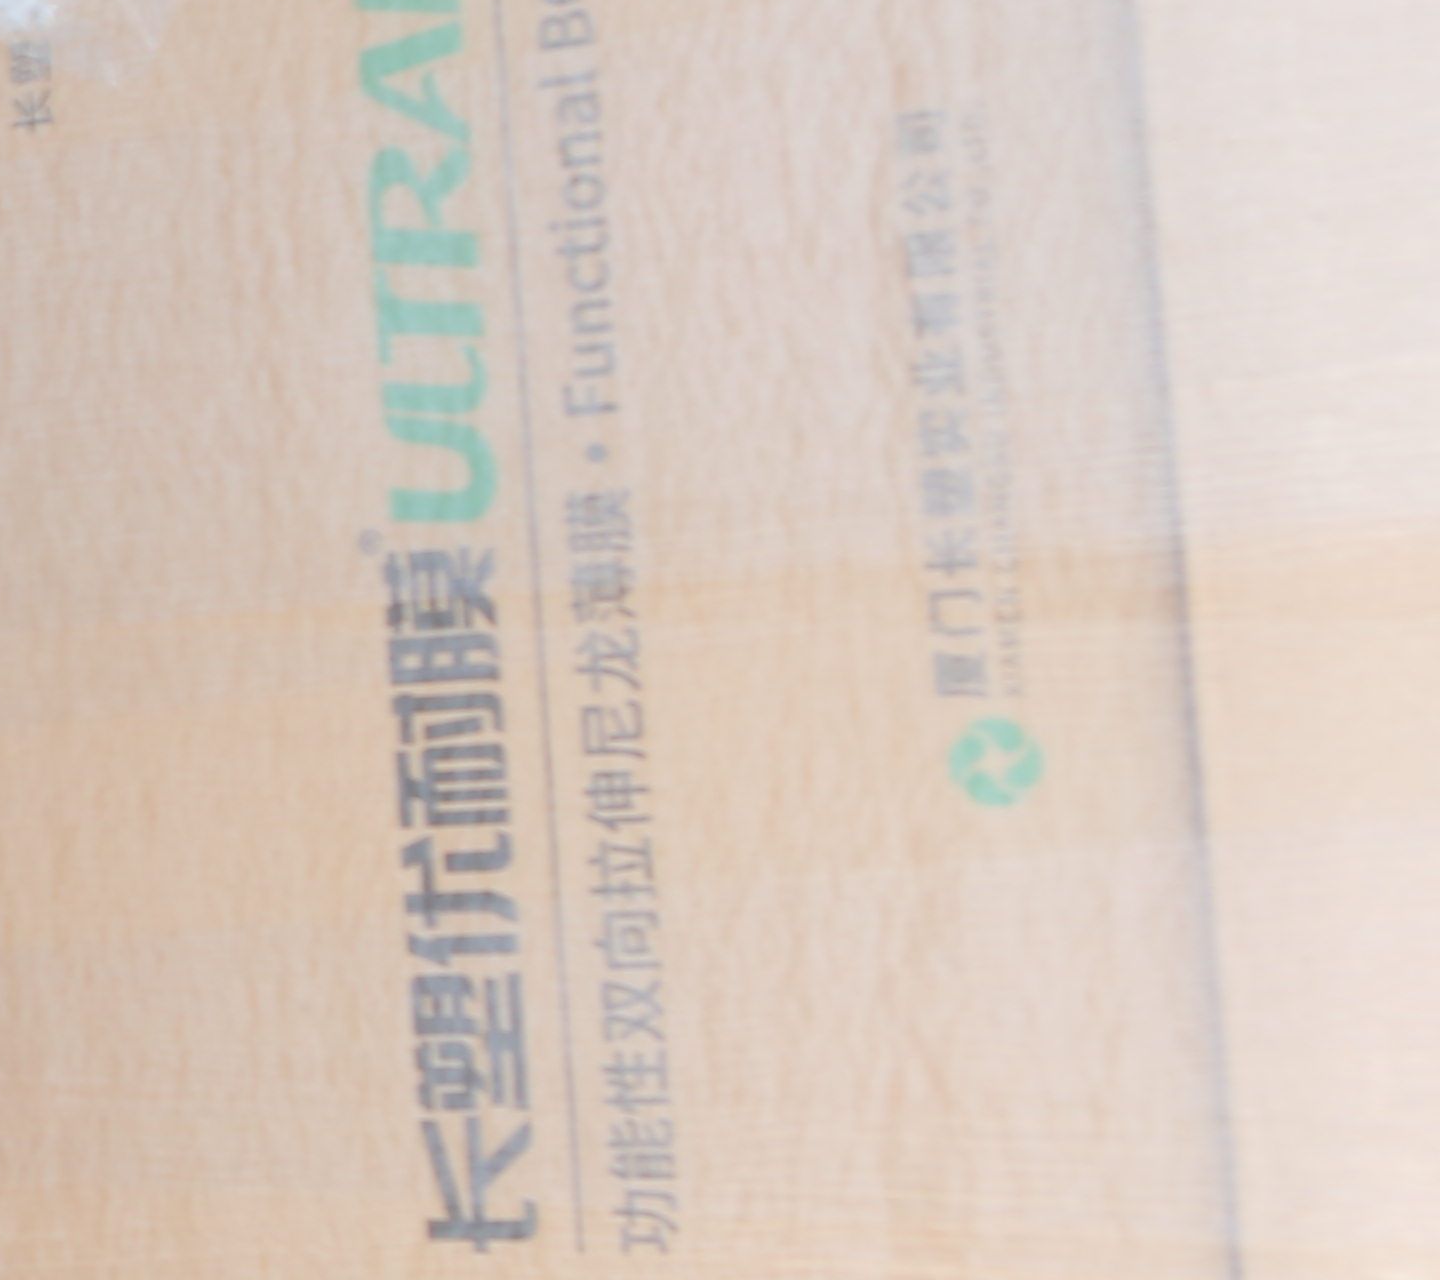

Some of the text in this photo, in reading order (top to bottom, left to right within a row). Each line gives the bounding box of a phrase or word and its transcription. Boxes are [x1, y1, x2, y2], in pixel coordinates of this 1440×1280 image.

[537, 70, 620, 418] Functional
[382, 543, 538, 1253] 长塑优耐膜
[564, 488, 680, 1256] 功能性双向拉伸尼龙薄膜
